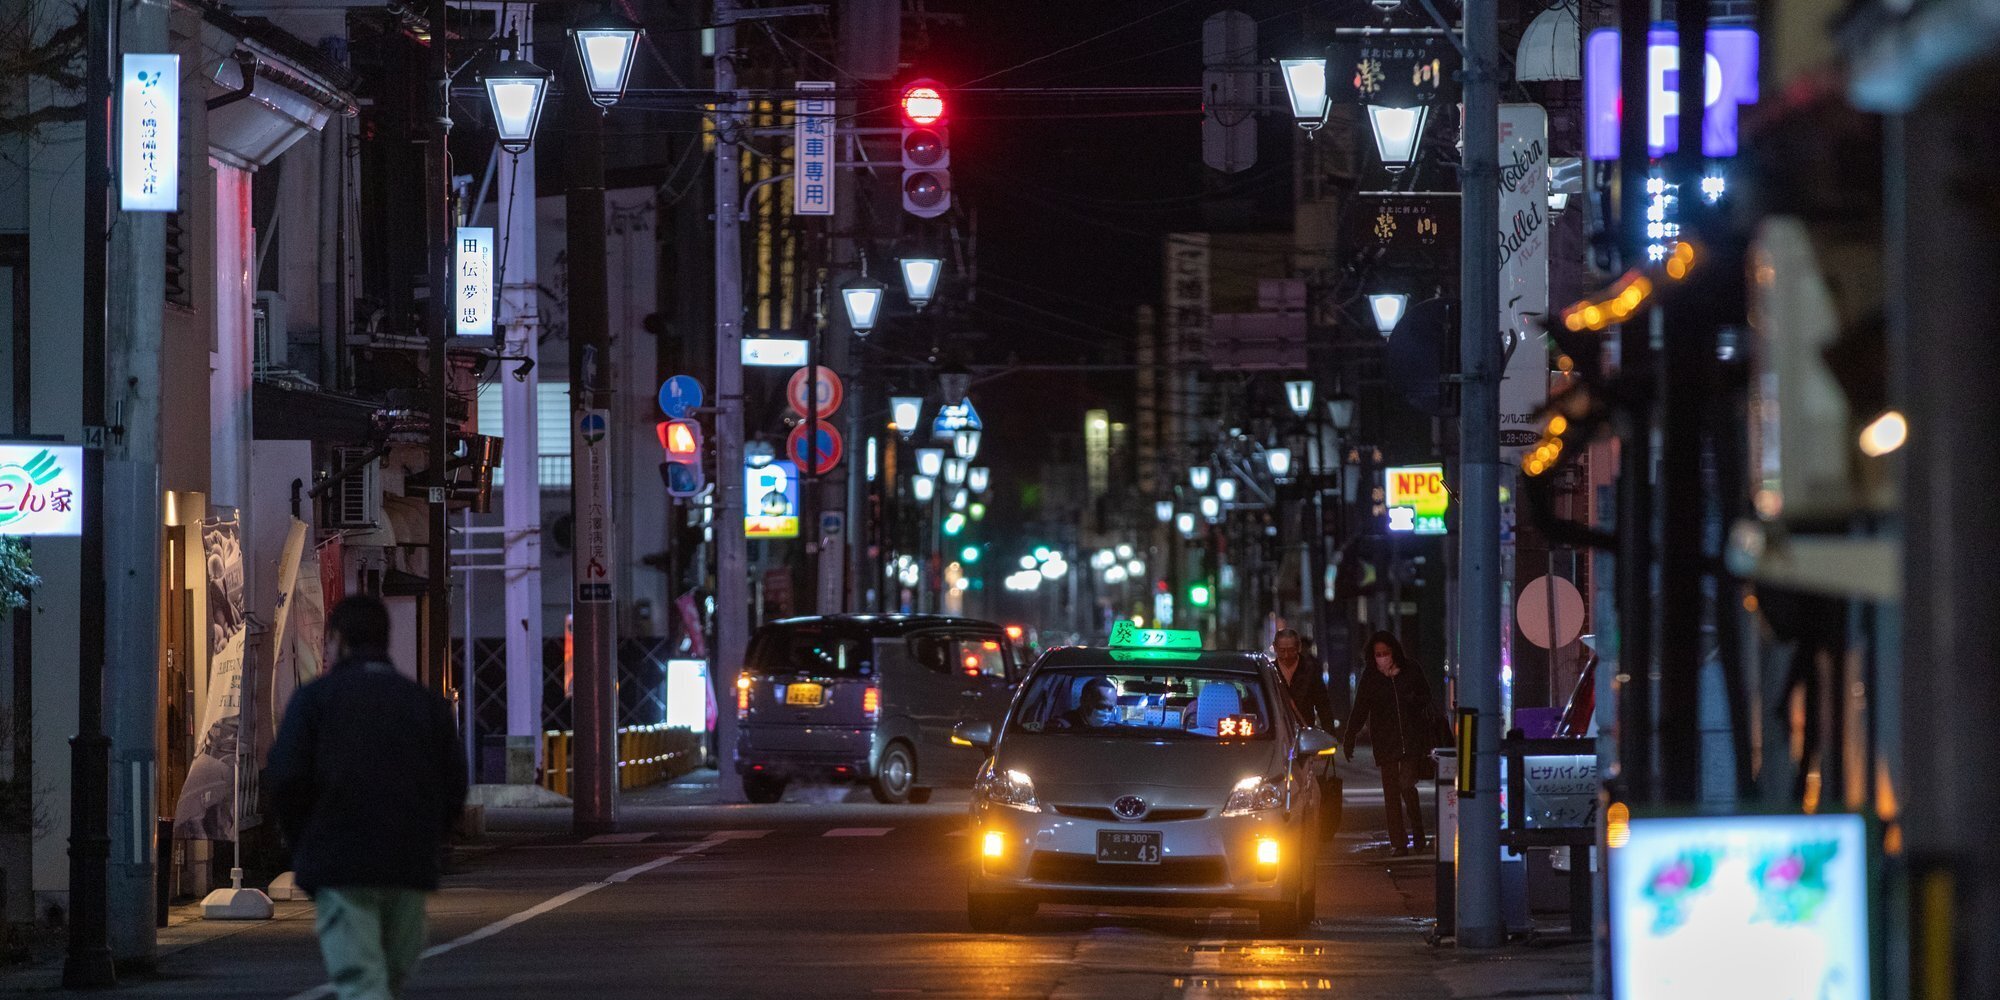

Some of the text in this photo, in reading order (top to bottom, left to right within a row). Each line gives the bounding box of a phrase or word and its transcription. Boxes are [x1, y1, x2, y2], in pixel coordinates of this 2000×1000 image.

[1648, 45, 1722, 147] P
[85, 428, 101, 446] 14
[1398, 473, 1439, 494] NPC
[430, 488, 443, 502] 13
[1115, 622, 1133, 645] 葵
[1141, 632, 1192, 645] タクシー
[1219, 718, 1254, 736] 支払
[1138, 844, 1158, 862] 43
